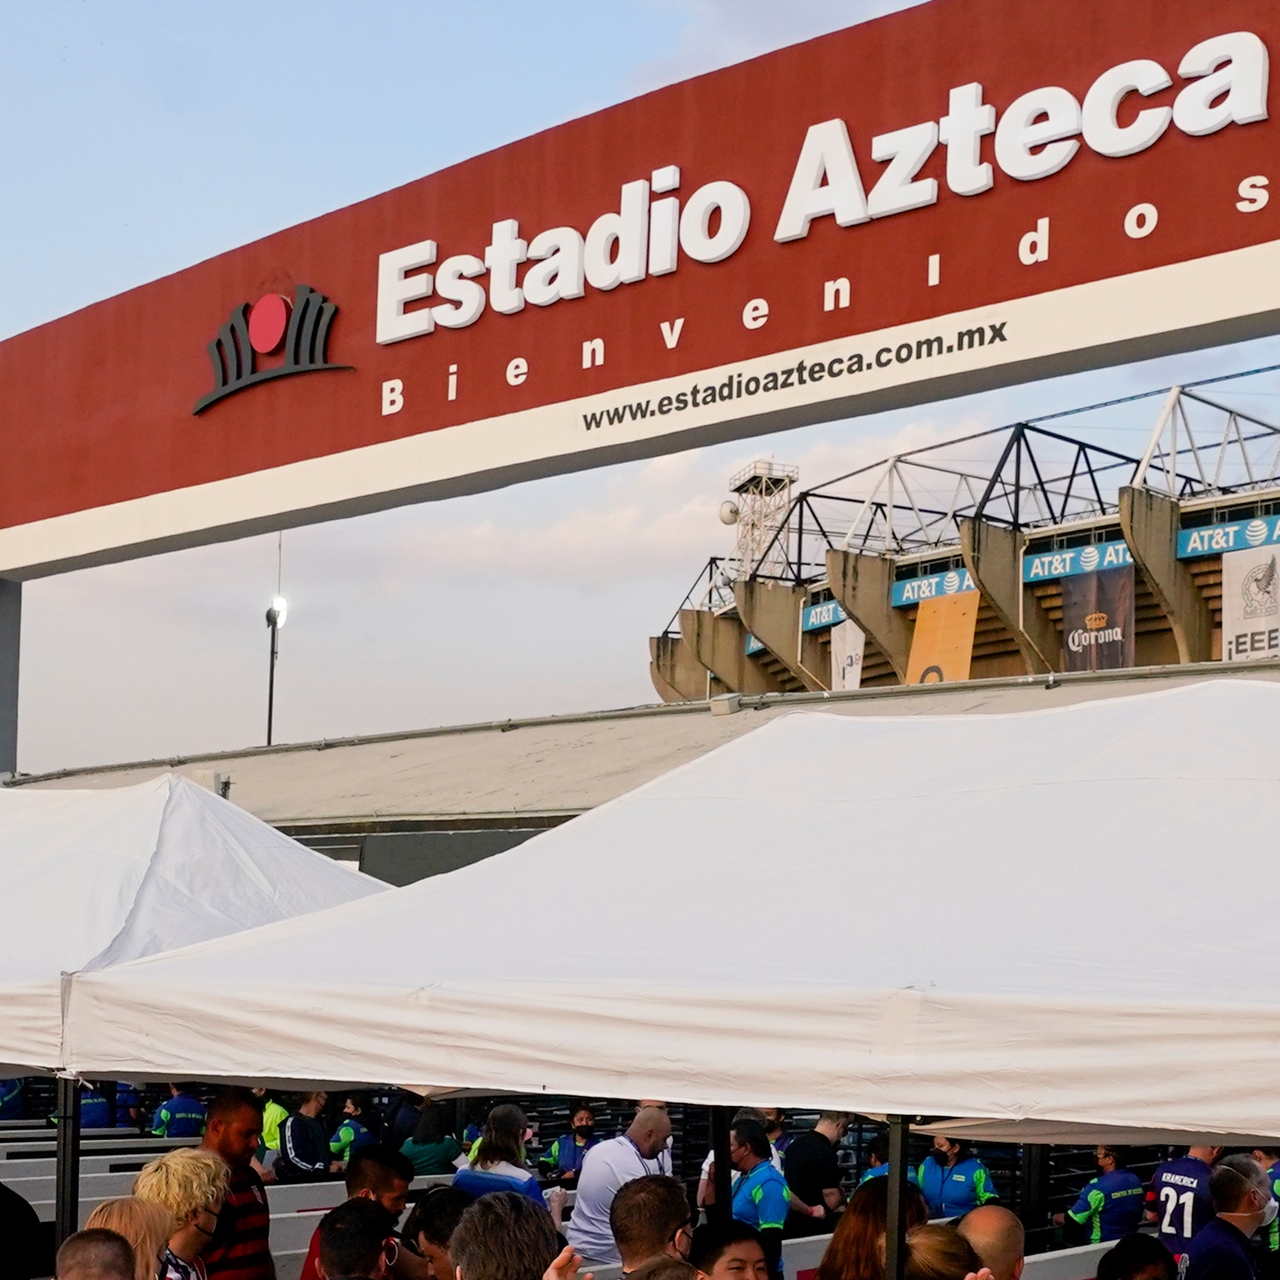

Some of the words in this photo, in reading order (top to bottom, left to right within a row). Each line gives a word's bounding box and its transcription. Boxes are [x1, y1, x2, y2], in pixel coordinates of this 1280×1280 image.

[375, 165, 751, 346] Estadio
[773, 30, 1271, 243] Azteca
[383, 174, 1271, 415] Bienvenidos
[582, 320, 1008, 431] www.estadioazteca.com.mx
[1187, 525, 1239, 553] AT&T
[1030, 557, 1071, 579] AT&T
[902, 577, 940, 601] AT&T
[808, 604, 834, 625] AT&T
[1067, 626, 1122, 653] Corona
[1159, 1186, 1196, 1239] 21
